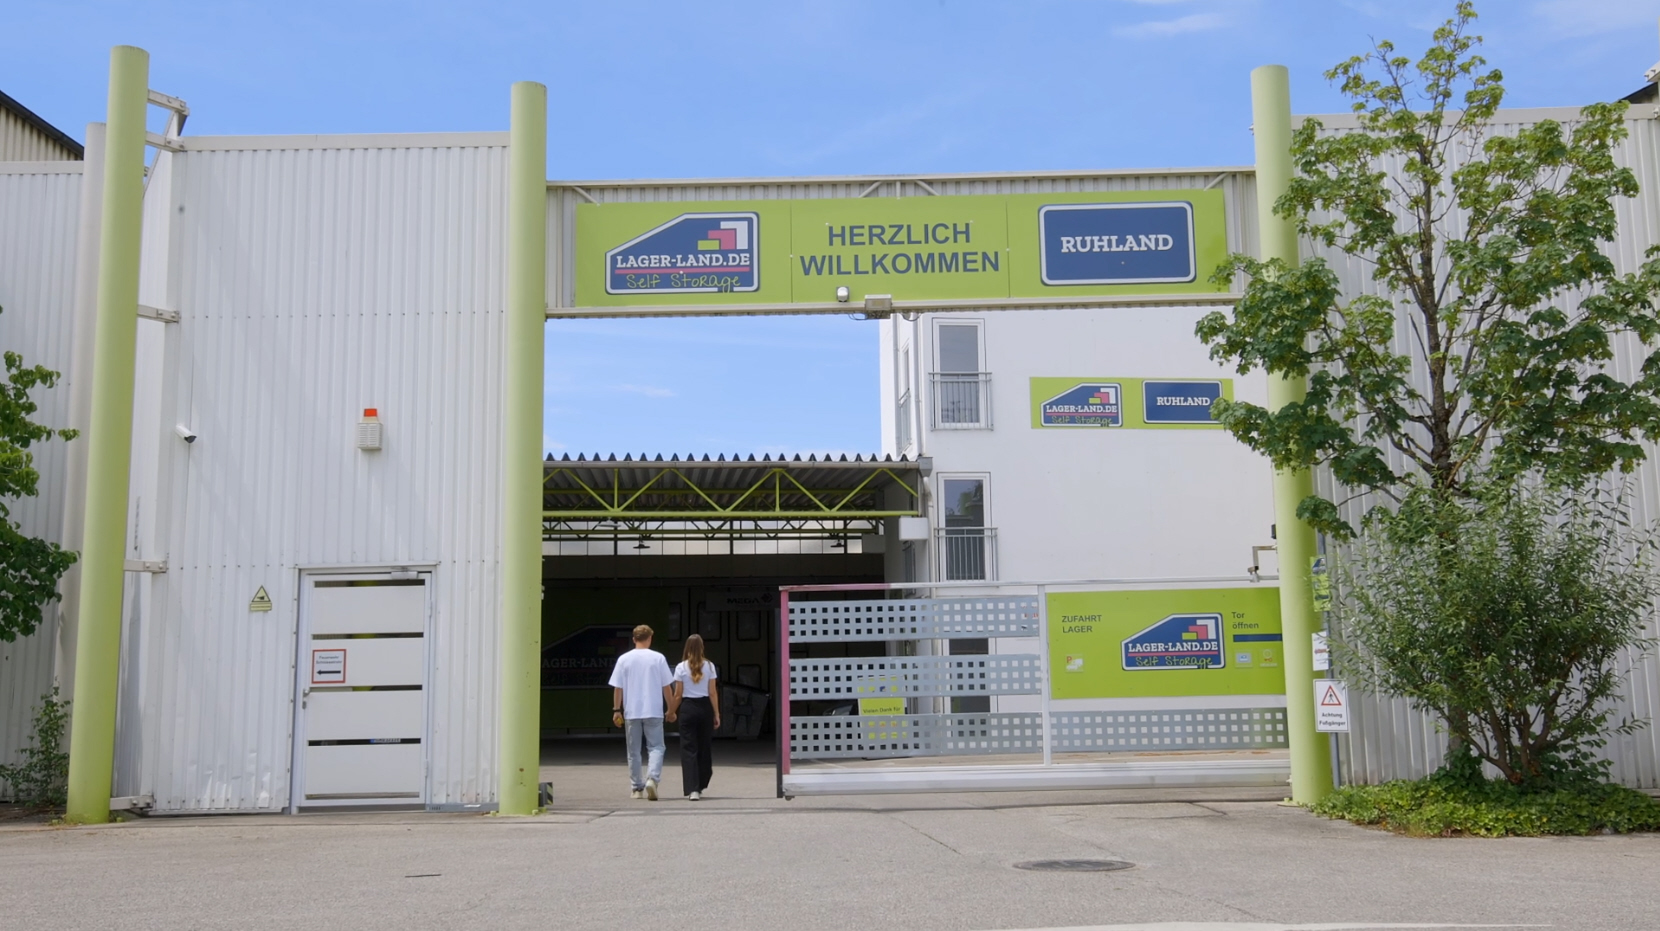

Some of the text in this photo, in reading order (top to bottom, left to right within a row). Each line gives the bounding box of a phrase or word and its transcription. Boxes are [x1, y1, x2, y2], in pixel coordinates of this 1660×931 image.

[828, 223, 971, 247] HERZLICH
[1060, 233, 1174, 254] RUHLAND
[616, 253, 750, 268] LAGER-LAND.DE
[800, 251, 1000, 276] WILLKOMMEN
[626, 273, 661, 289] Self
[1156, 396, 1211, 407] RUHLAND
[1046, 404, 1118, 414] LAGER-LAND.DE
[1052, 415, 1070, 425] Self
[1061, 614, 1102, 623] ZUFAHRT
[1232, 611, 1245, 619] Tor
[1062, 625, 1093, 634] LAGER
[1232, 621, 1259, 630] öffnen
[1128, 641, 1218, 653] LAGER-LAND.DE
[1135, 656, 1159, 667] Self
